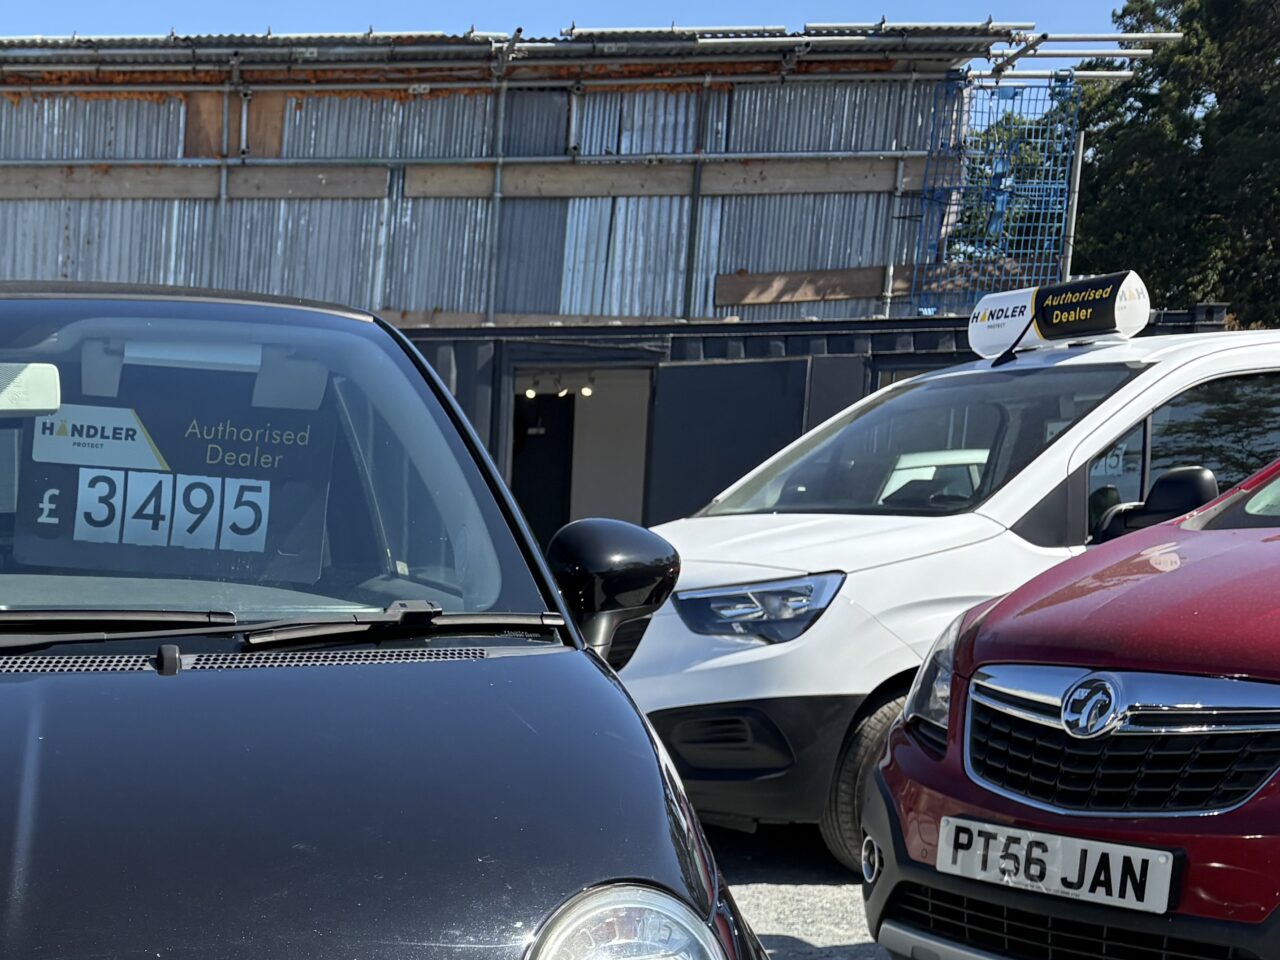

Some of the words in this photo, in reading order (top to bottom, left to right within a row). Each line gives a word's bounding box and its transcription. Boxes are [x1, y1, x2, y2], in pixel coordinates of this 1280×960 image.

[1043, 284, 1113, 307] Authorised
[1052, 307, 1093, 324] Dealer
[72, 441, 104, 449] PROTECT
[184, 419, 310, 447] Authorised
[206, 443, 284, 468] Dealer
[951, 825, 1049, 883] PT56
[1060, 848, 1150, 903] JAN
